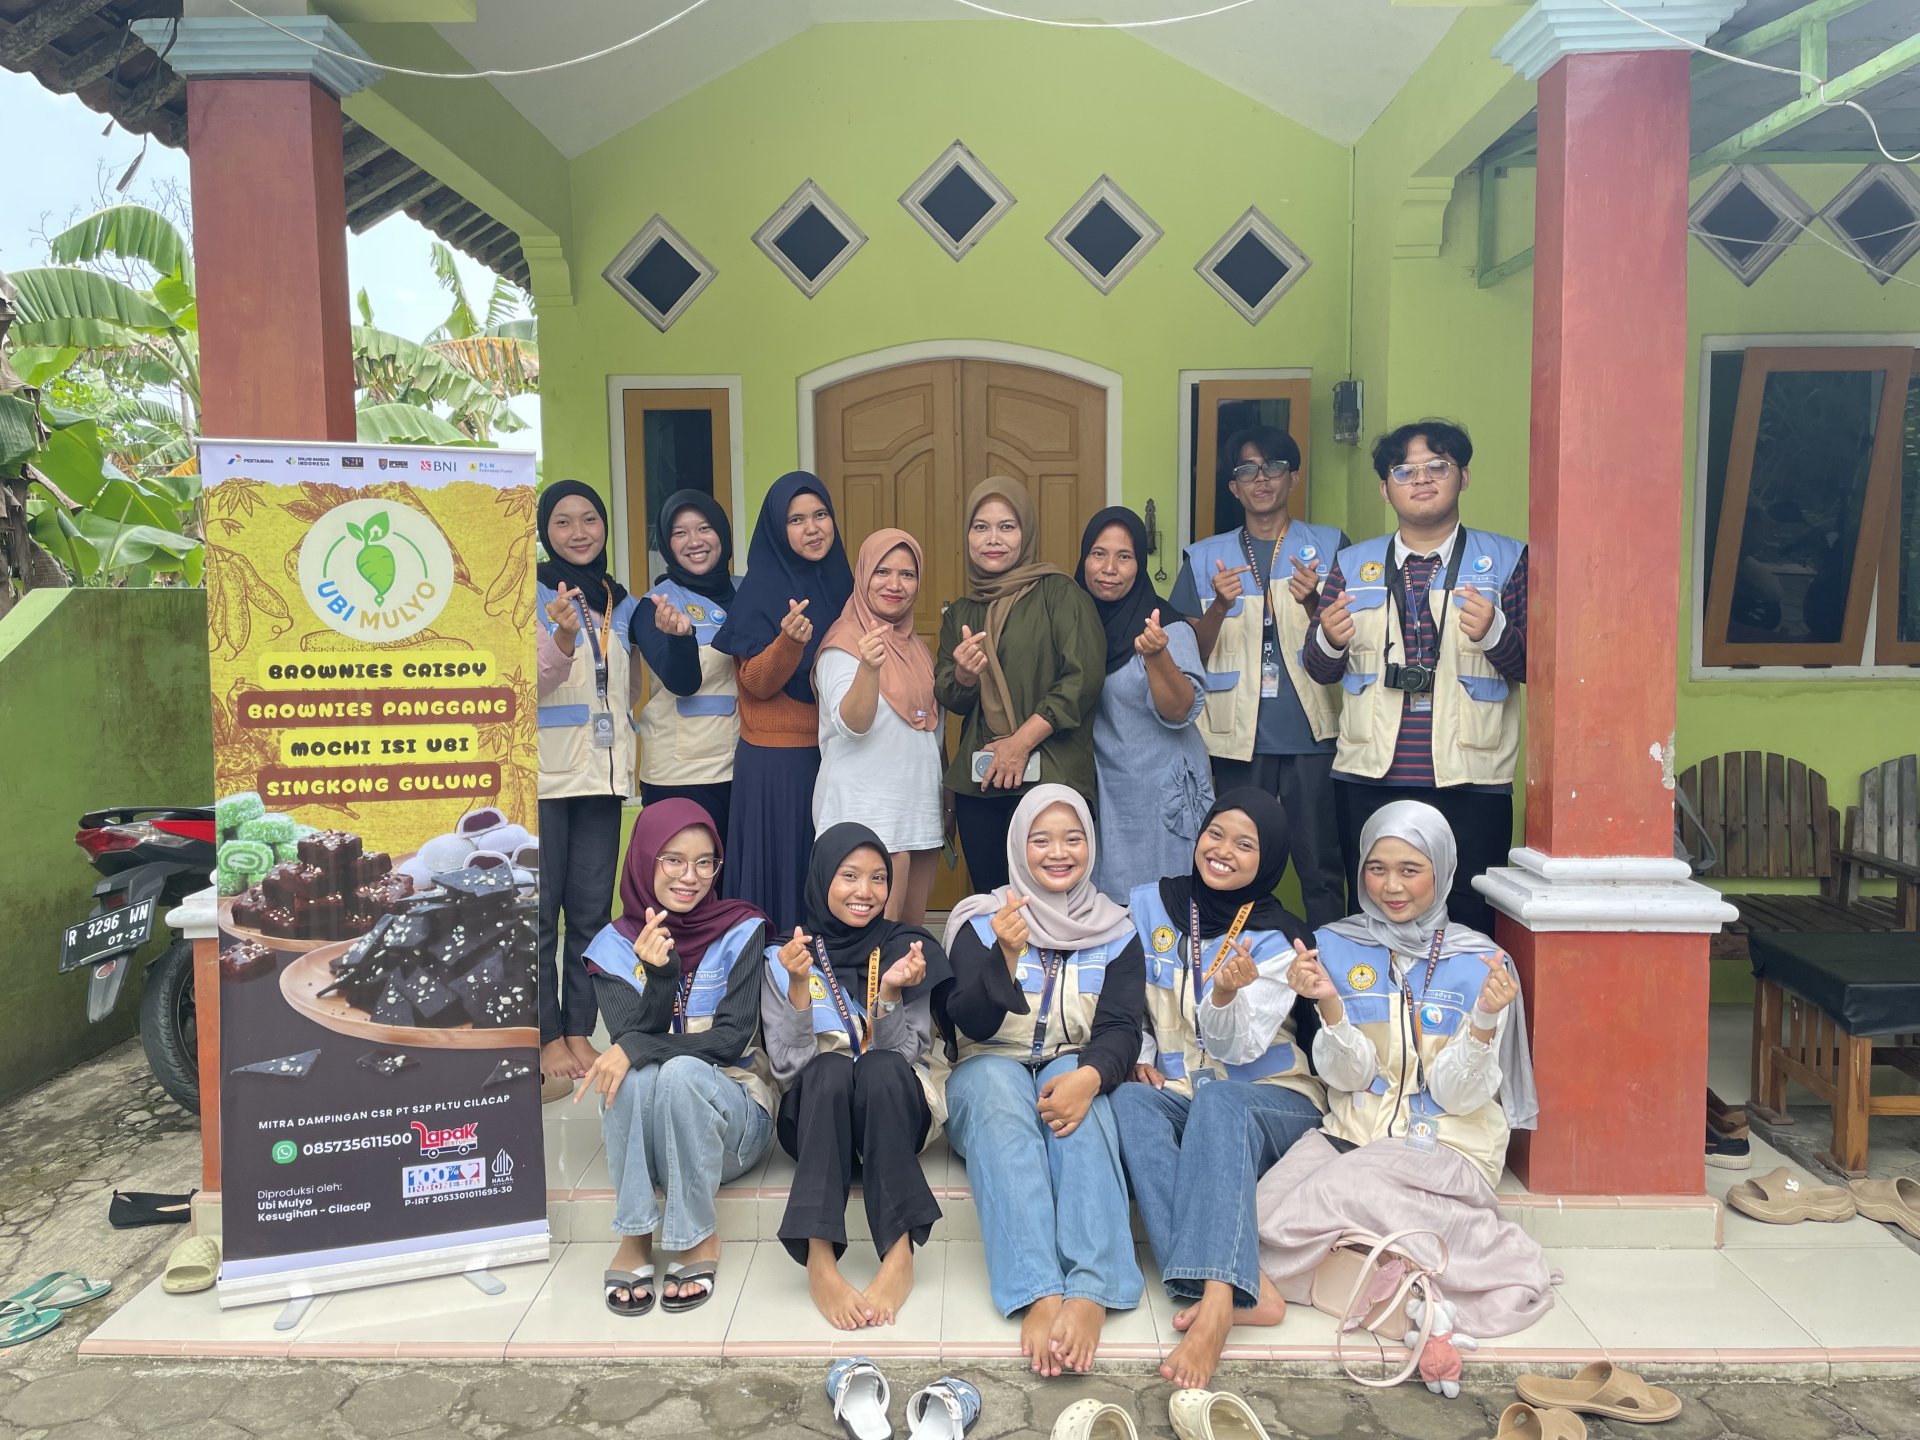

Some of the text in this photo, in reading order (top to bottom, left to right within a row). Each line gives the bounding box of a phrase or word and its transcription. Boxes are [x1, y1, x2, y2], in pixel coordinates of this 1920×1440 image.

[344, 457, 362, 467] S2P
[434, 461, 457, 472] BNI
[318, 580, 436, 630] UBI MULYO
[268, 662, 487, 680] BROWNIES CRISPY
[248, 700, 508, 719] BROWNIES PANGGANG
[291, 738, 469, 757] MOCHI ISI UBI
[266, 774, 492, 796] SINGKONG GULUNG
[68, 903, 149, 947] R 3296 WN
[1220, 926, 1239, 955] UNOED
[258, 1094, 510, 1130] MITRA DAMPINGAN CSR PT S2P PLTU CILACAP
[302, 1132, 412, 1156] 085735611500
[492, 1176, 514, 1184] HALAL
[258, 1182, 343, 1200] Diproduksi oleh:
[258, 1198, 312, 1210] Ubi Mulyo
[404, 1197, 430, 1206] P-IRT
[258, 1208, 318, 1222] Kesugihan
[328, 1202, 372, 1214] Cilacap
